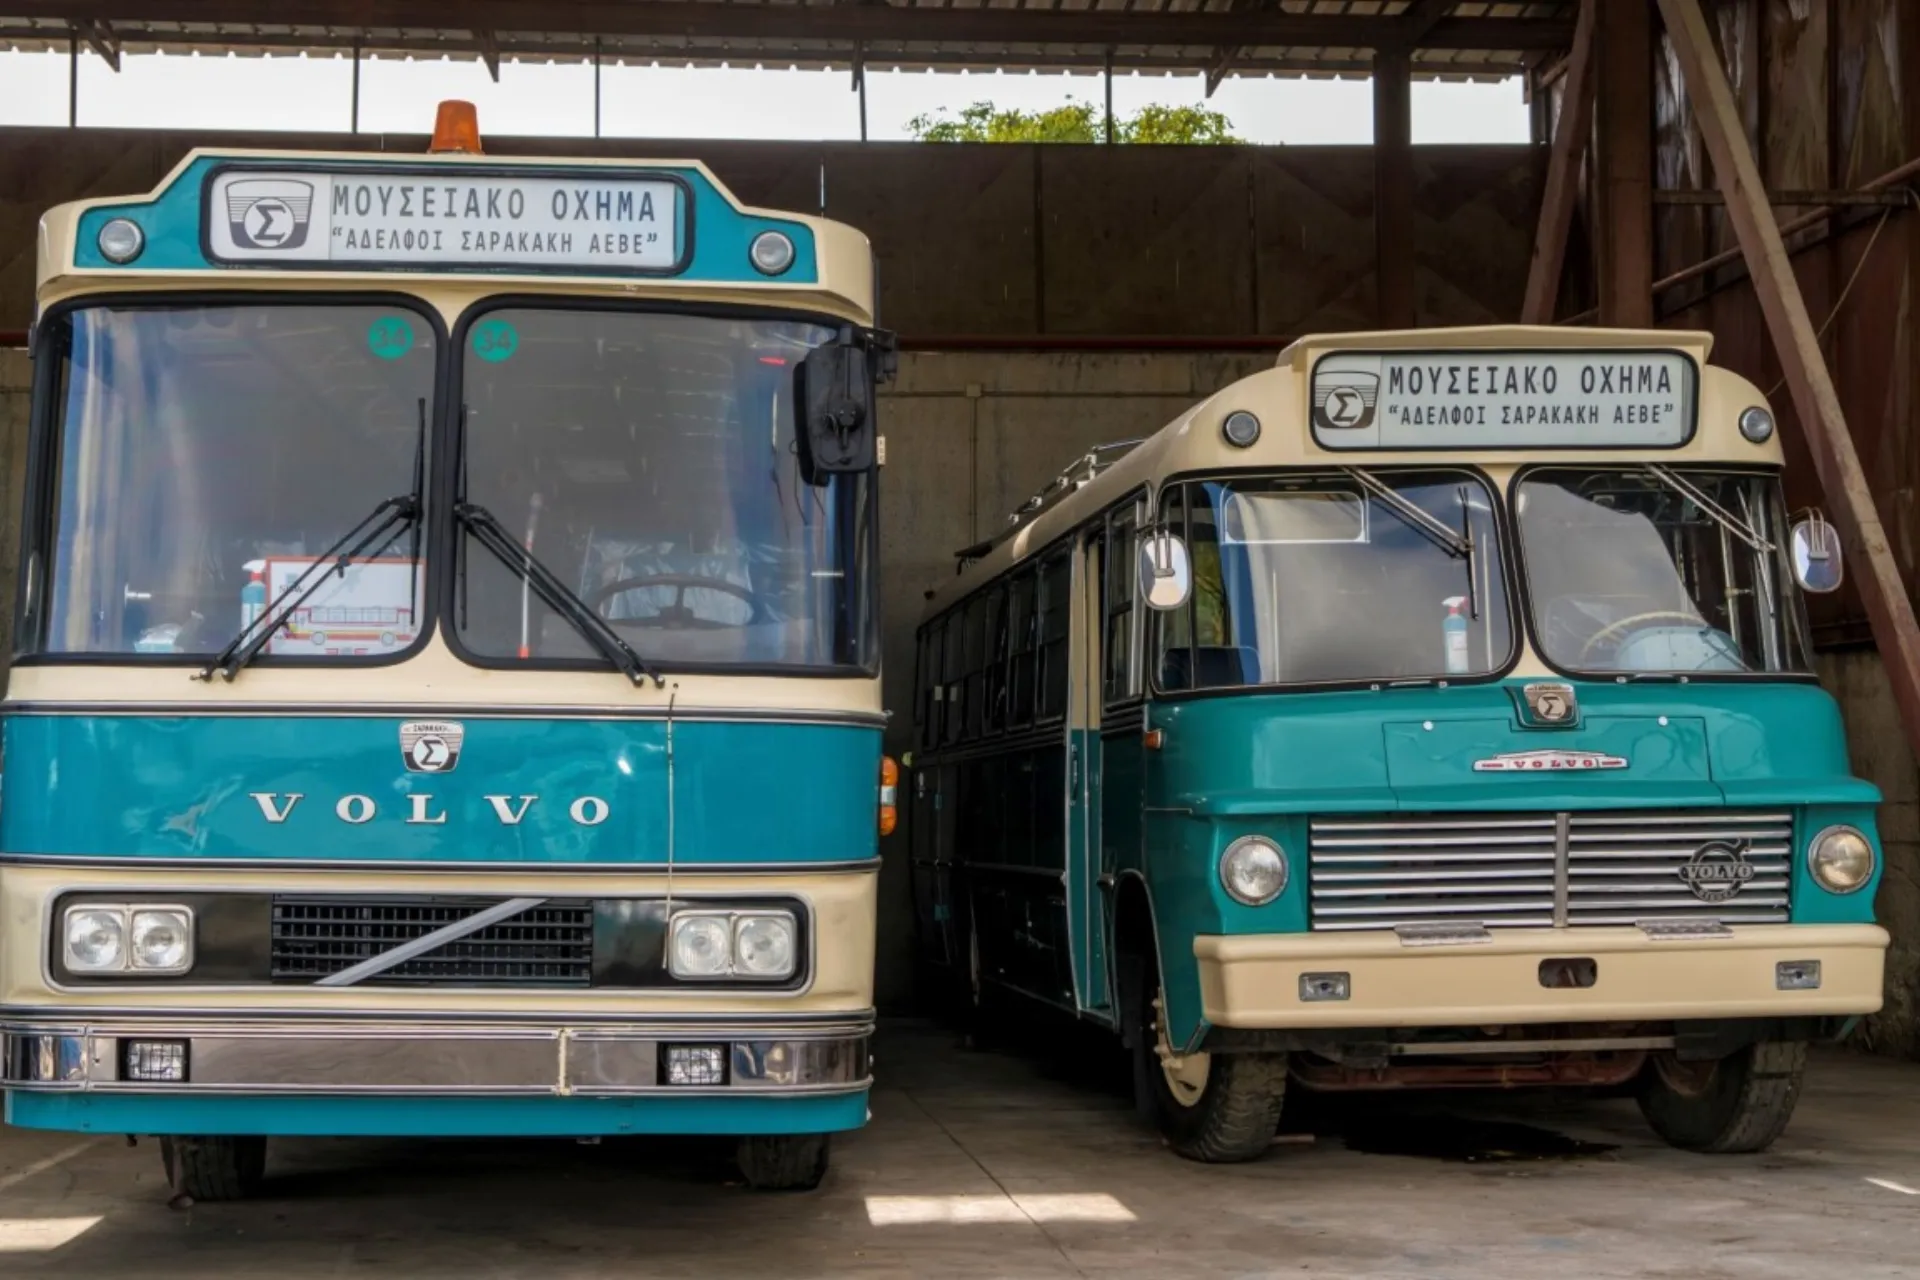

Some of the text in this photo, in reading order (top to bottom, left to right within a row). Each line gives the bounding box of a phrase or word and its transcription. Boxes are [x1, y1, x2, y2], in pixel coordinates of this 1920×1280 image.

[332, 184, 655, 222] ΜΟΥΣΕΙΑΚΟ ΟΧΗΜΑ
[461, 230, 573, 253] ΣΑΡΑΚΑΚΗ
[482, 330, 512, 351] 34
[1389, 365, 1671, 395] ΜΟΥΣΕΙΑΚΟ ΟΧΗΜΑ
[1501, 404, 1599, 425] ΣΑΡΑΚΑΚΗ
[1513, 759, 1593, 770] VOLVO
[249, 792, 610, 826] VOLVO
[1686, 864, 1751, 880] VOLVO
